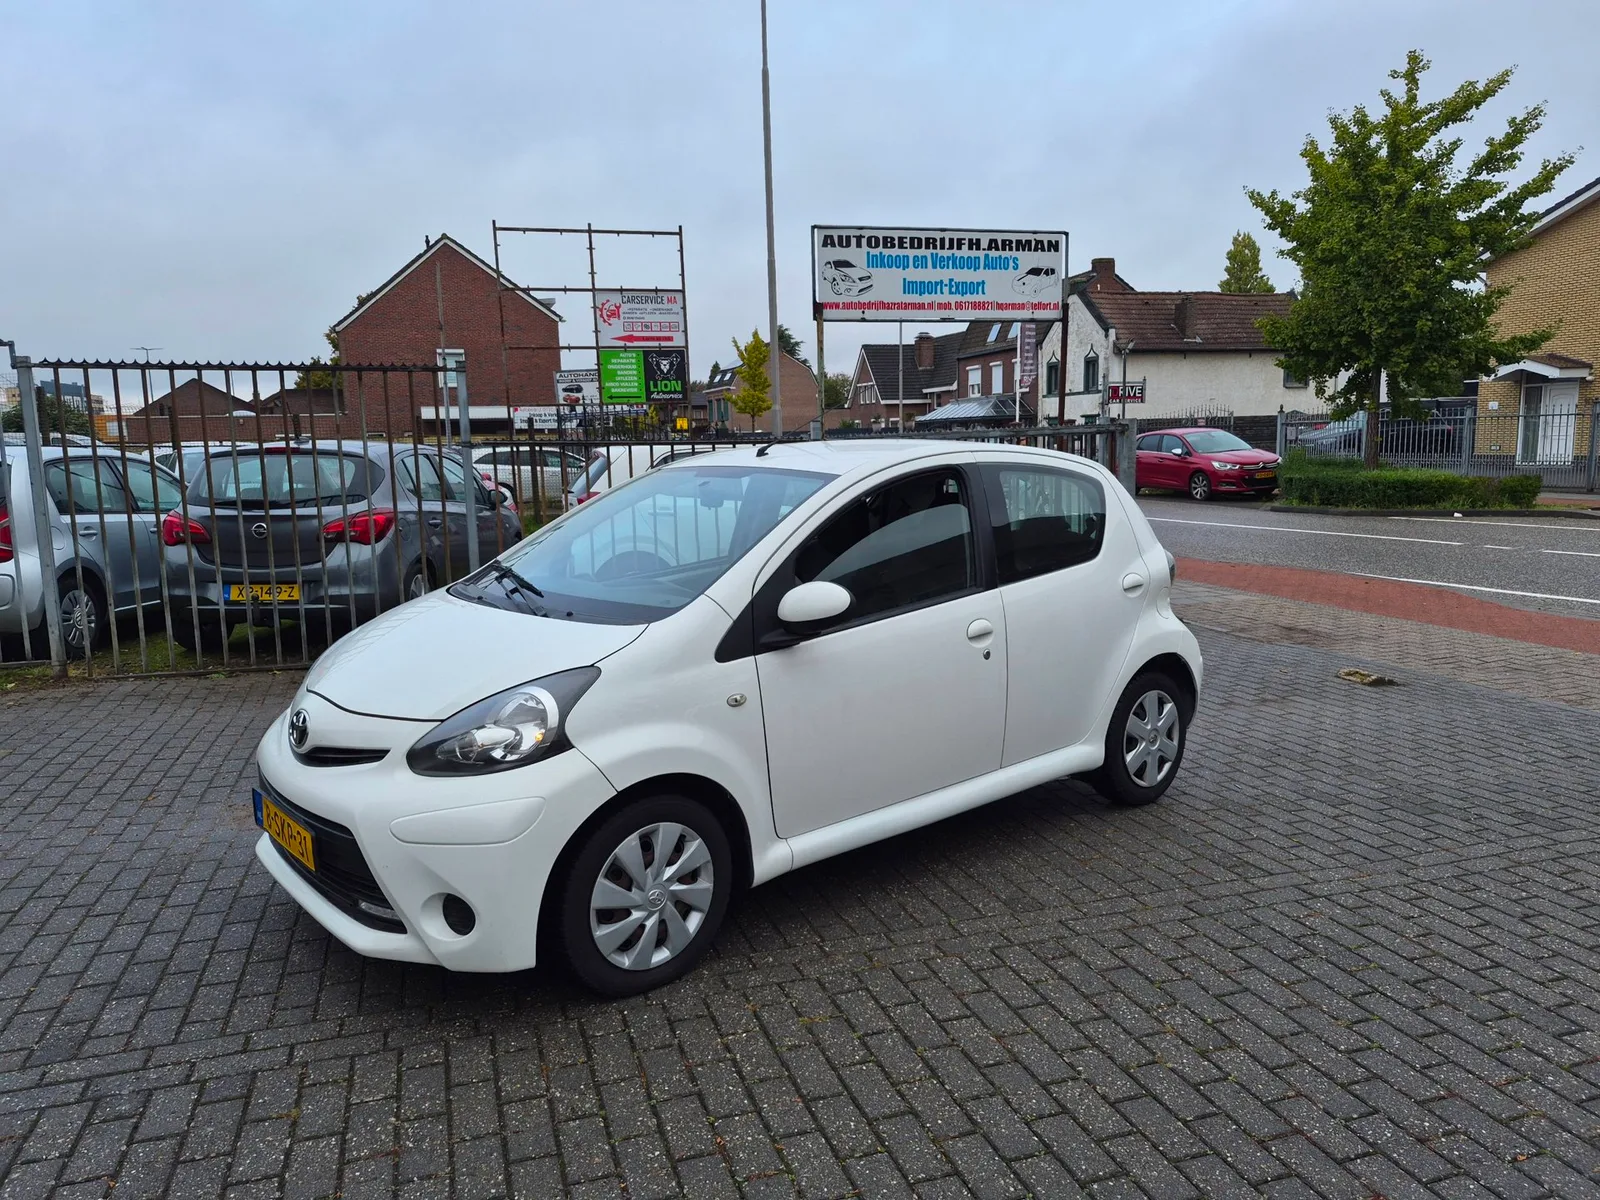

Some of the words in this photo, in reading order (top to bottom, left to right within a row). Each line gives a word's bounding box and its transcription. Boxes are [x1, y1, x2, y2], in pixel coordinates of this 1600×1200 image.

[821, 234, 1060, 253] AUTOBEDRIJFH.ARMAN
[866, 251, 909, 270] Inkoop
[912, 256, 928, 269] en
[930, 252, 980, 272] Verkoop
[983, 253, 1019, 271] Auto's
[902, 277, 986, 297] Import-Export
[621, 295, 665, 305] CARSERVICE
[667, 296, 678, 305] MA
[650, 380, 682, 392] LION
[650, 391, 683, 400] Autoservice
[266, 804, 309, 862] 8-SKP-31
